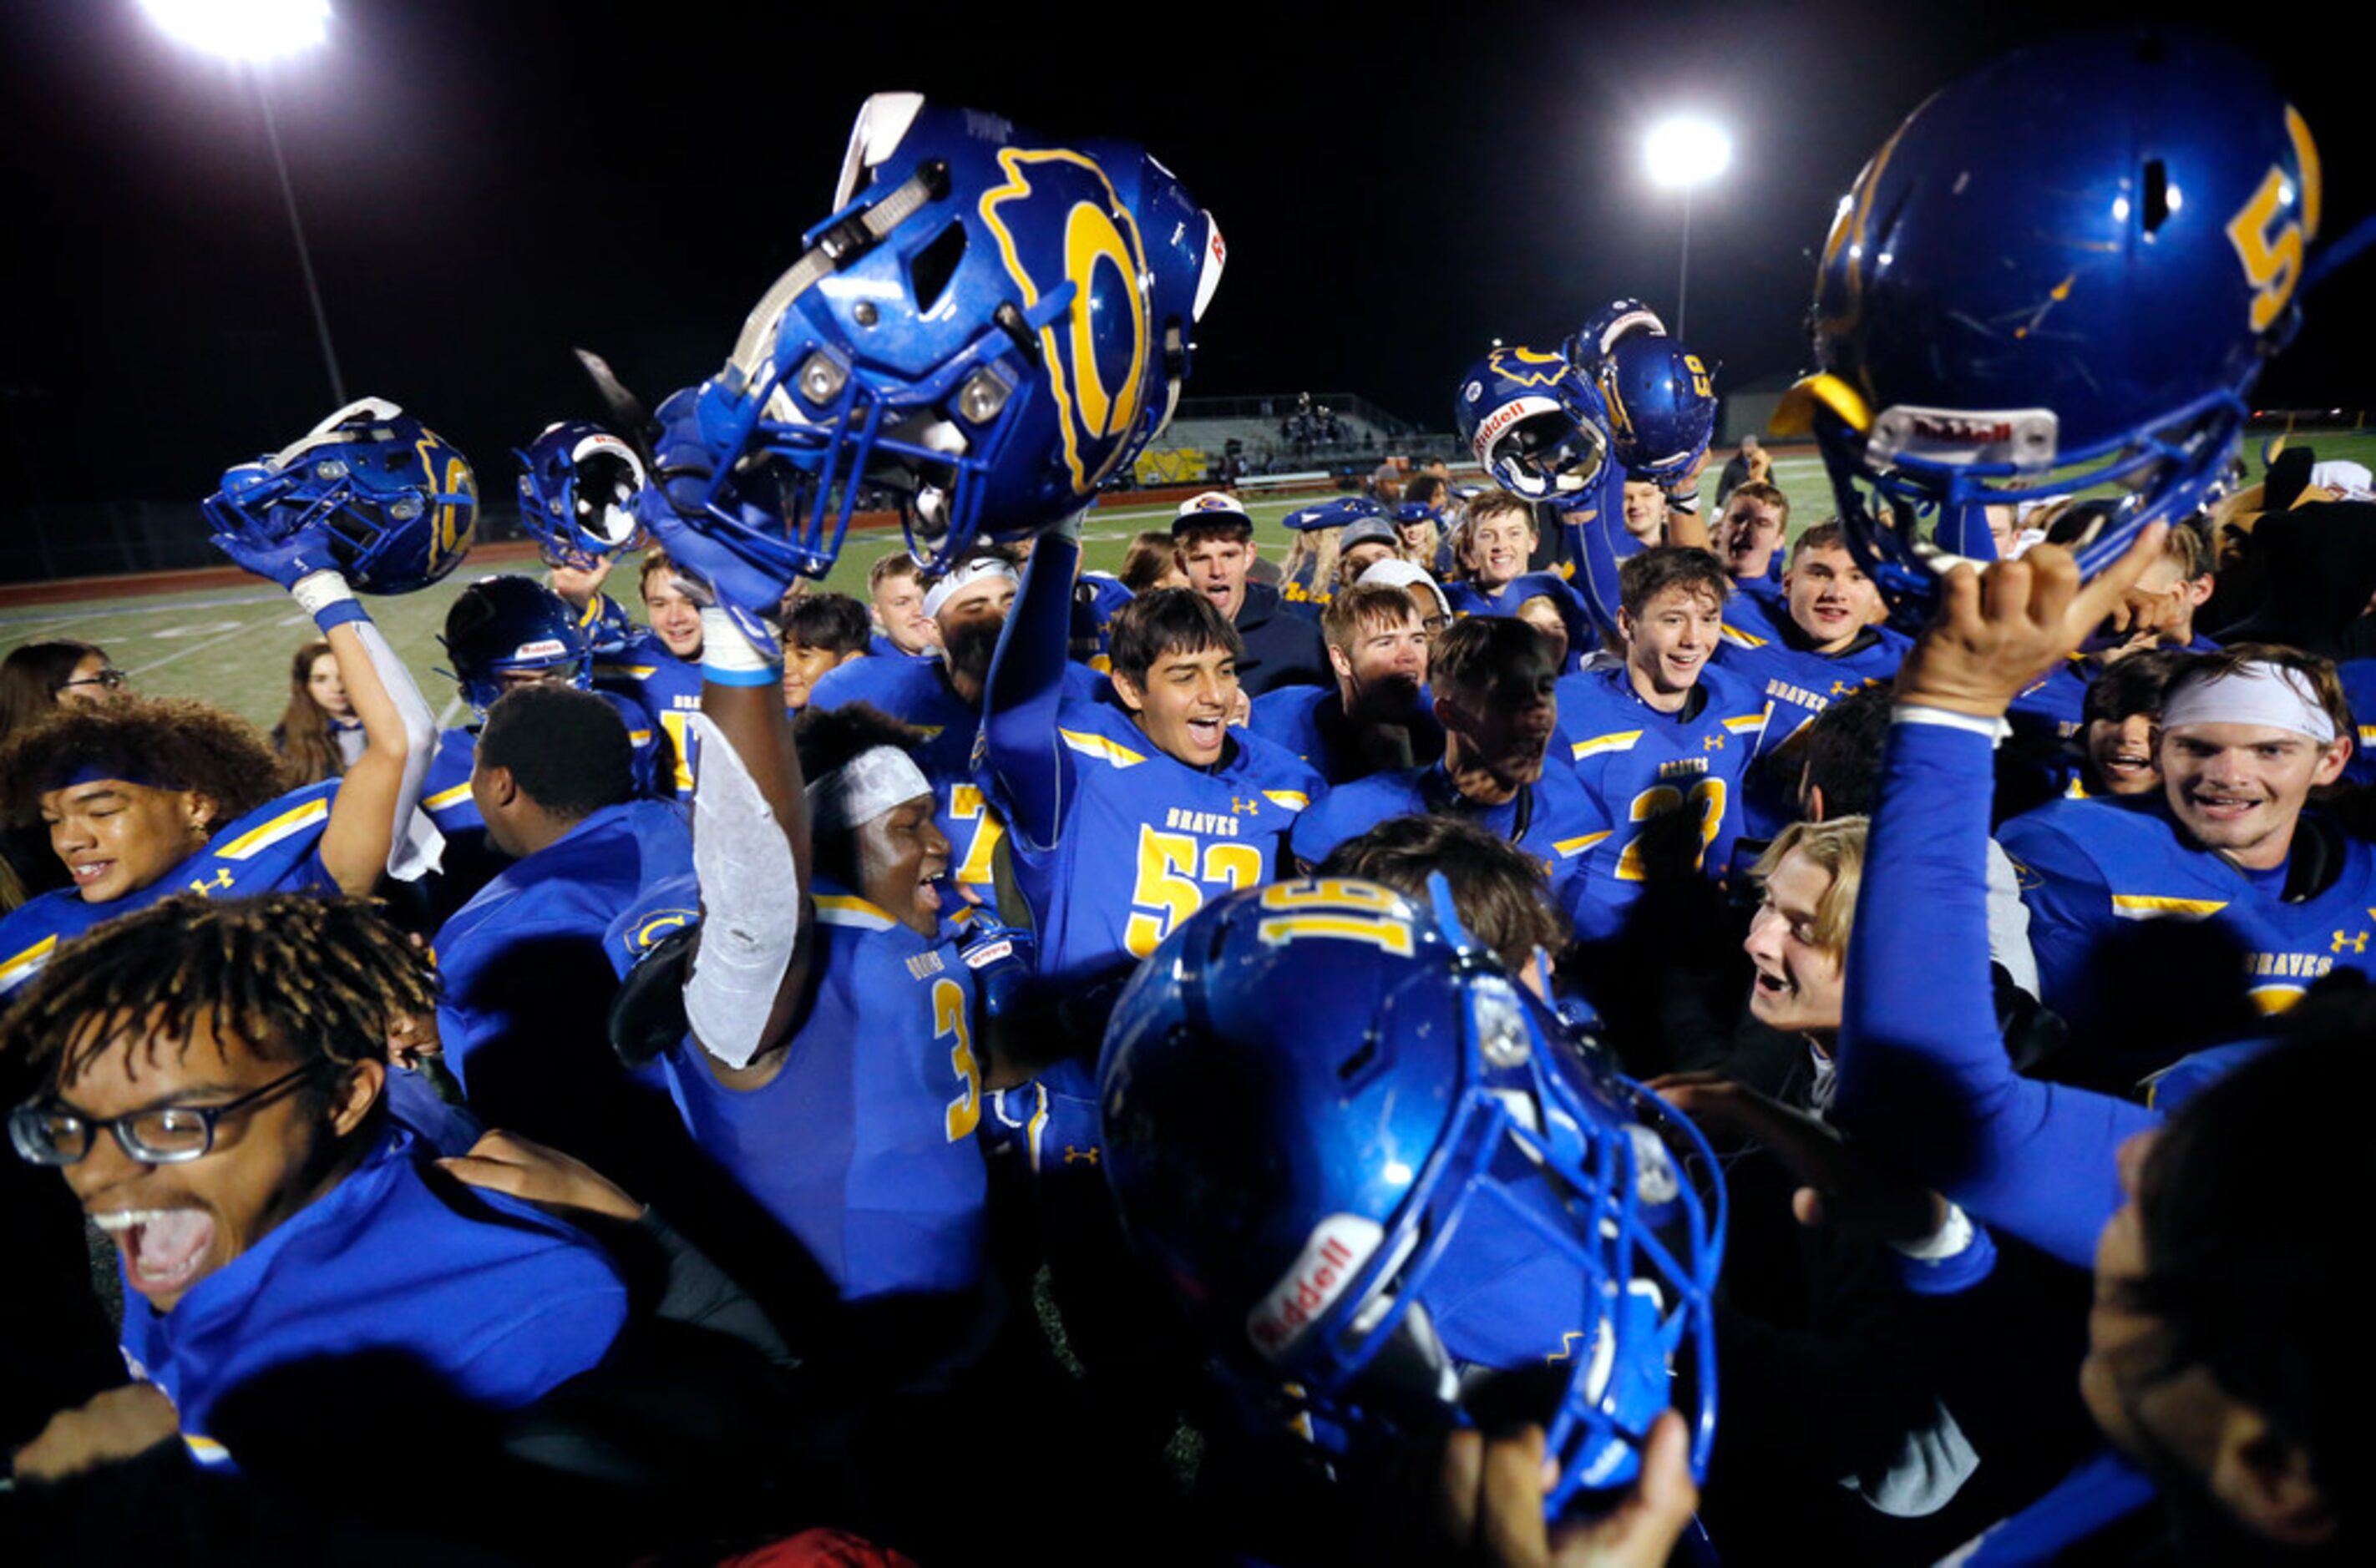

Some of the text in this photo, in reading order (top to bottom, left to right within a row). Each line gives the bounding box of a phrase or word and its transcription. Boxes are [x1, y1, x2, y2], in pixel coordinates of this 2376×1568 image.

[1765, 678, 1830, 712] BRAVES
[1166, 807, 1239, 836] BRAVES
[1257, 878, 1416, 959] 16
[931, 978, 981, 1143] 3
[1253, 1236, 1353, 1348] Riddell
